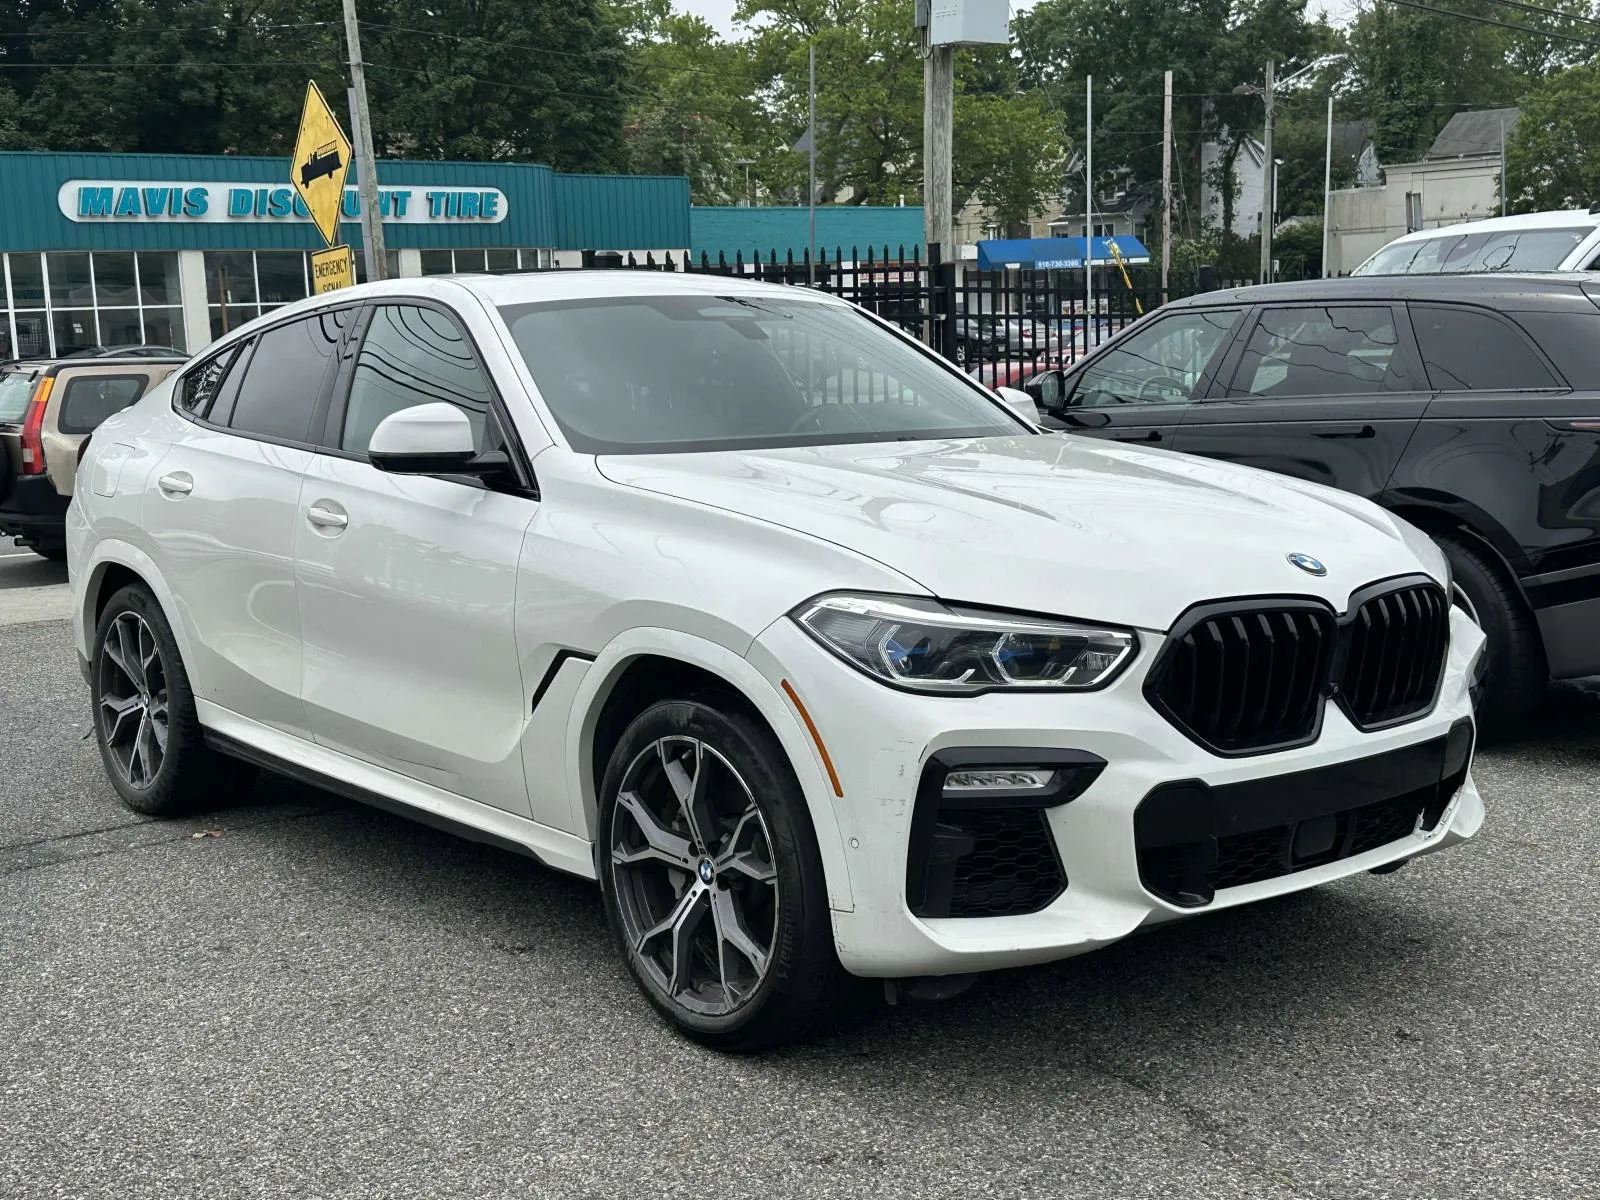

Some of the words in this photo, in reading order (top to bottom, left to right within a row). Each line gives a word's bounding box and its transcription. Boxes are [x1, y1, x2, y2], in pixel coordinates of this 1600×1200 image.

[78, 187, 209, 217] MAVIS
[228, 188, 412, 217] DISUNT
[426, 191, 499, 217] TIRE
[314, 257, 347, 278] EMERGENCY
